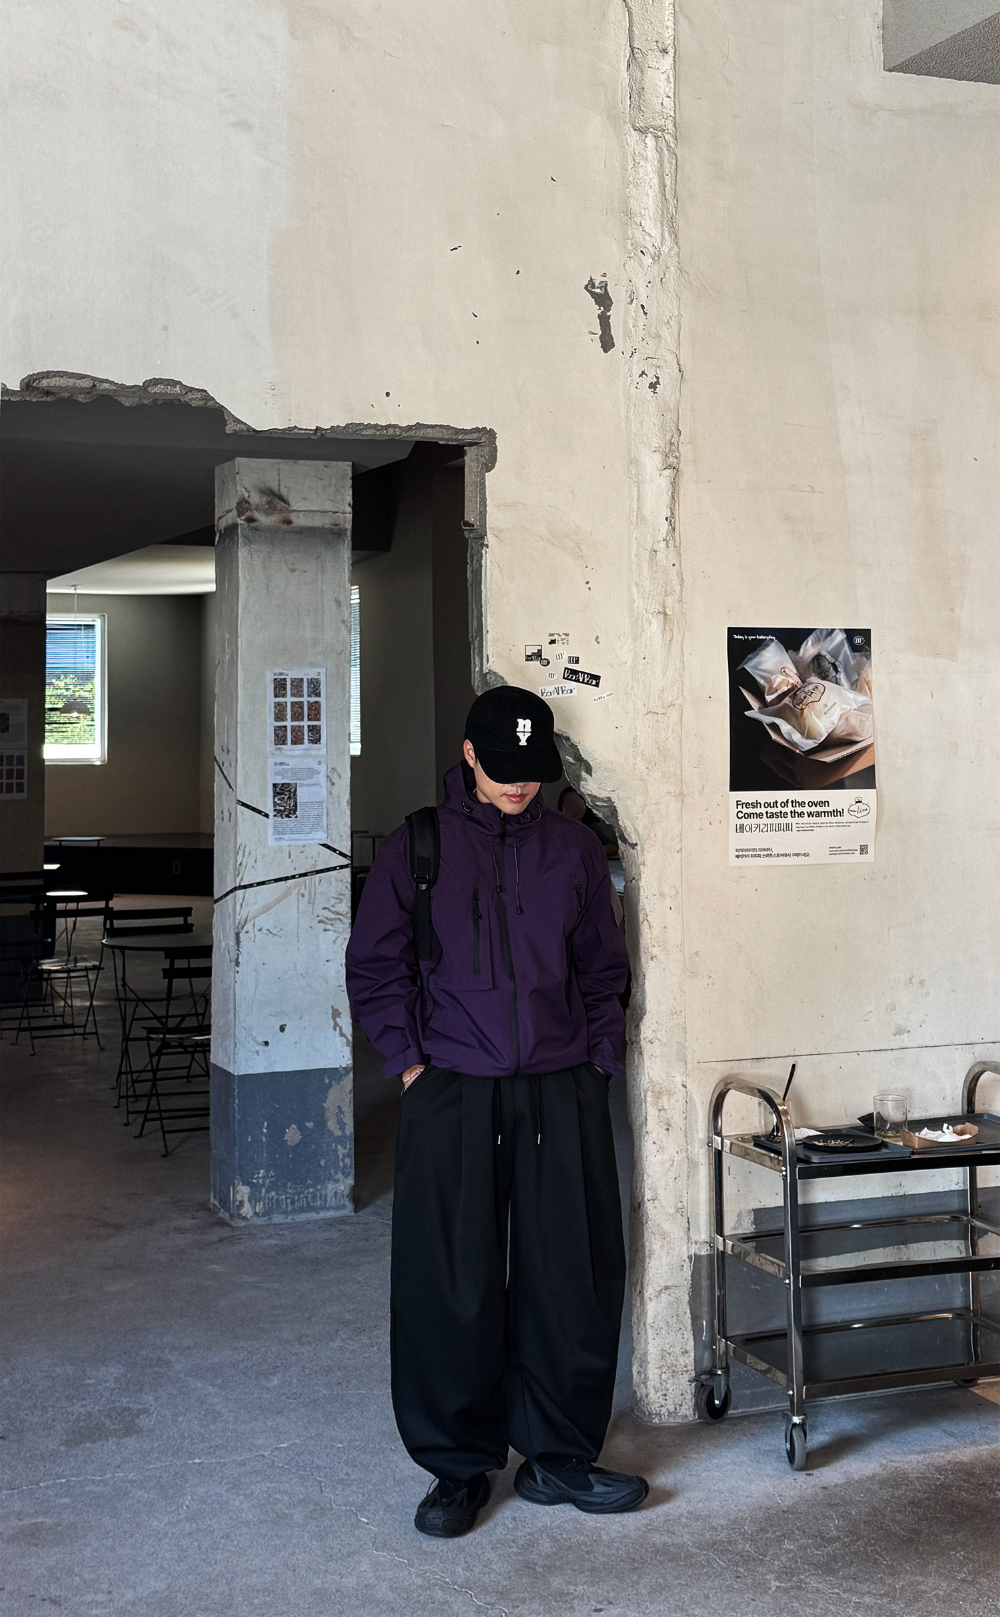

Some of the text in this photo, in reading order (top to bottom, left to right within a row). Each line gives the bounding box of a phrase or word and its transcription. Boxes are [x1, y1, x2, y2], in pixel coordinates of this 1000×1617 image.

[735, 798, 830, 810] Fresh out of the oven
[735, 810, 764, 820] Come
[765, 810, 789, 819] taste
[789, 808, 806, 819] the
[806, 808, 845, 818] warmth!
